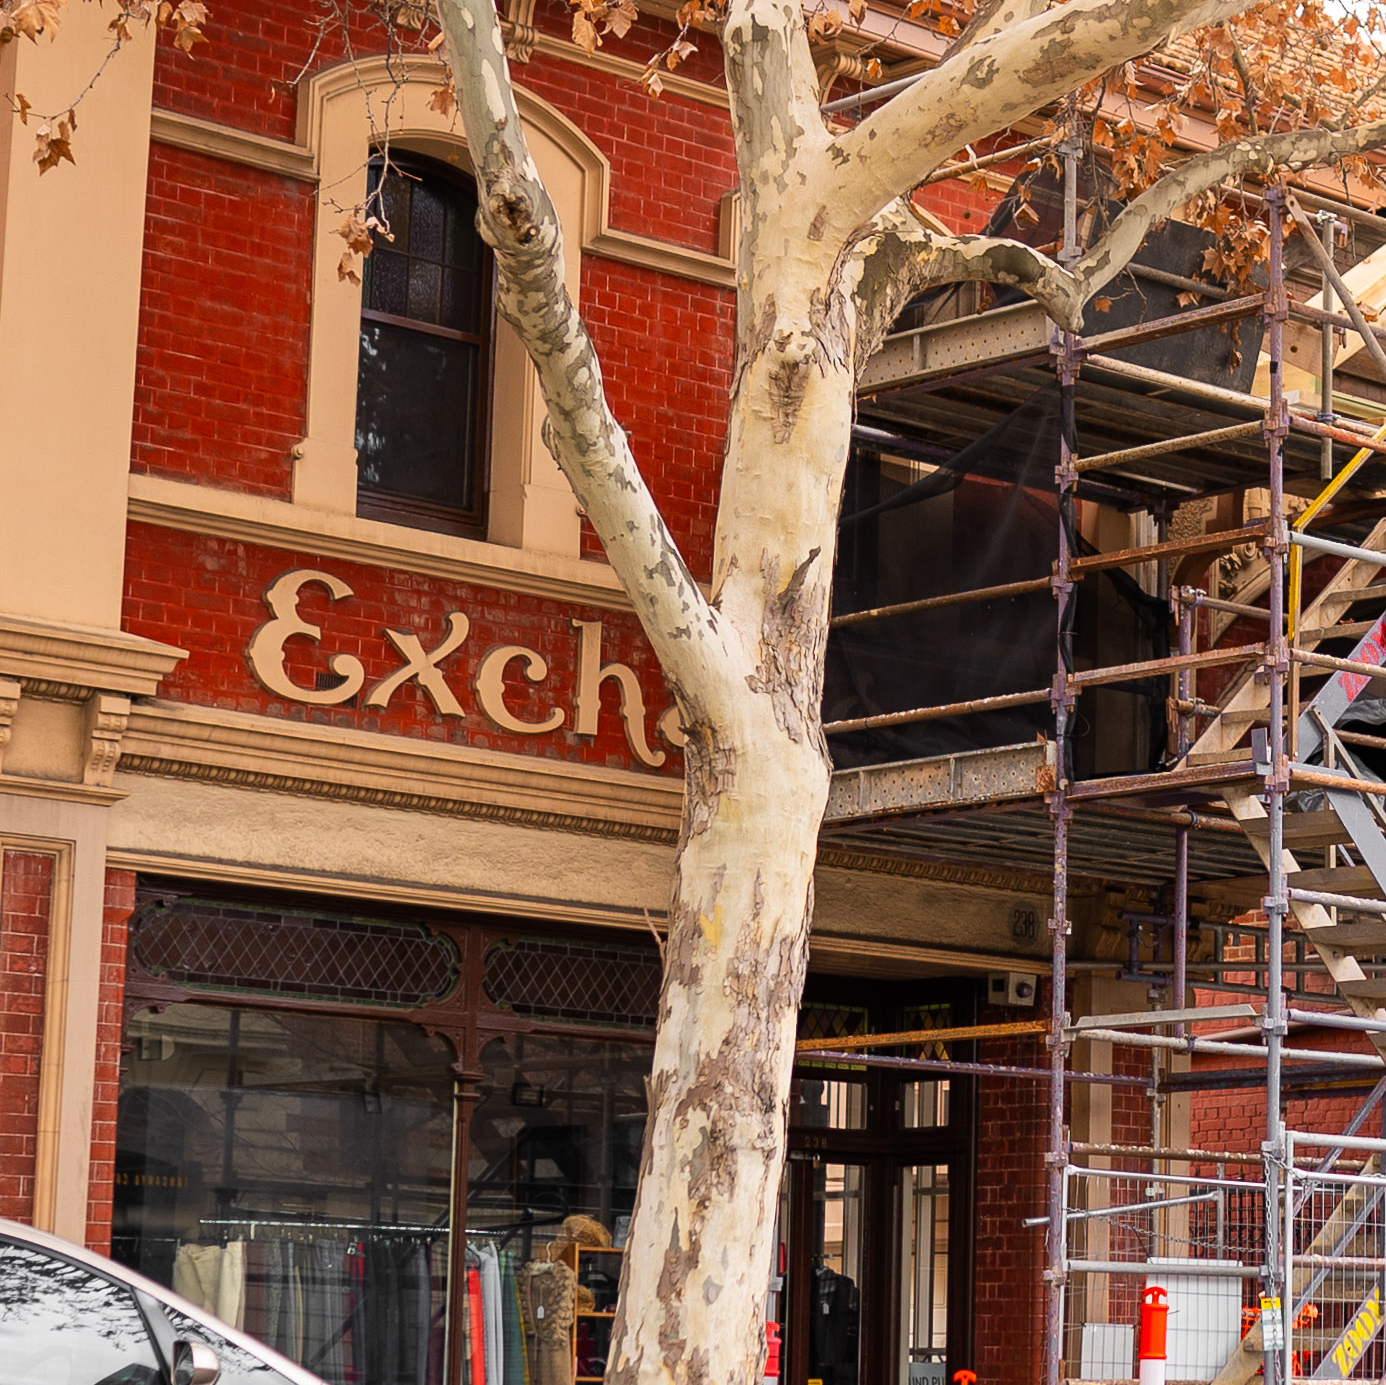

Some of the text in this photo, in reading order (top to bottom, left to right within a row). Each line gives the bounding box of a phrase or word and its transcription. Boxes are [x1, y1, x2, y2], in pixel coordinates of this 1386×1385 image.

[247, 569, 686, 768] Exch
[1013, 909, 1035, 938] 238
[804, 1136, 827, 1149] 238
